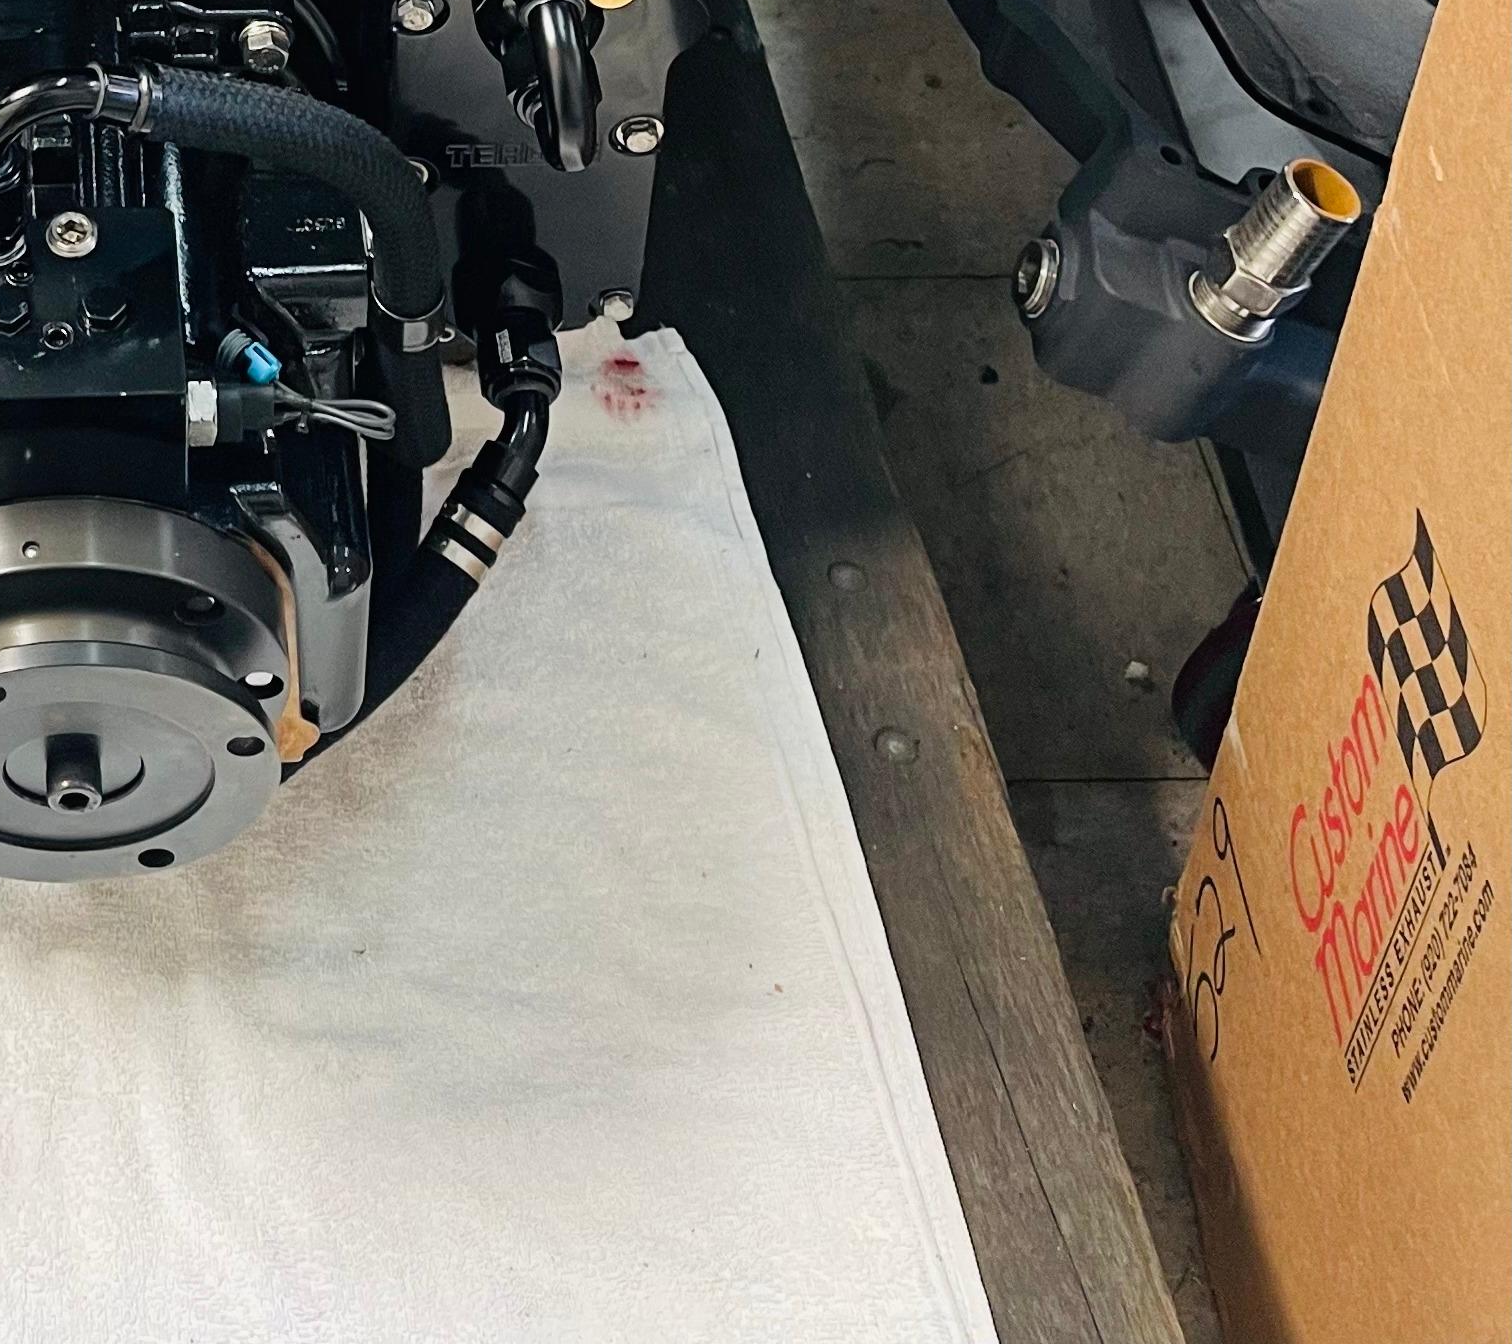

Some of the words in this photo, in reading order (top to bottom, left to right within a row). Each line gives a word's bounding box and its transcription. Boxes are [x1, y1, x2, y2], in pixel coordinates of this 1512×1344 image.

[1289, 673, 1388, 934] Custom
[1314, 782, 1421, 1049] Marine
[1346, 964, 1396, 1085] STAINLESS
[1392, 850, 1439, 966] EXHAUST
[1389, 976, 1427, 1060] PHONE:
[1420, 926, 1447, 993] (920)
[1438, 840, 1479, 941] 722-7084
[1400, 878, 1496, 1105] www.custommarine.com
